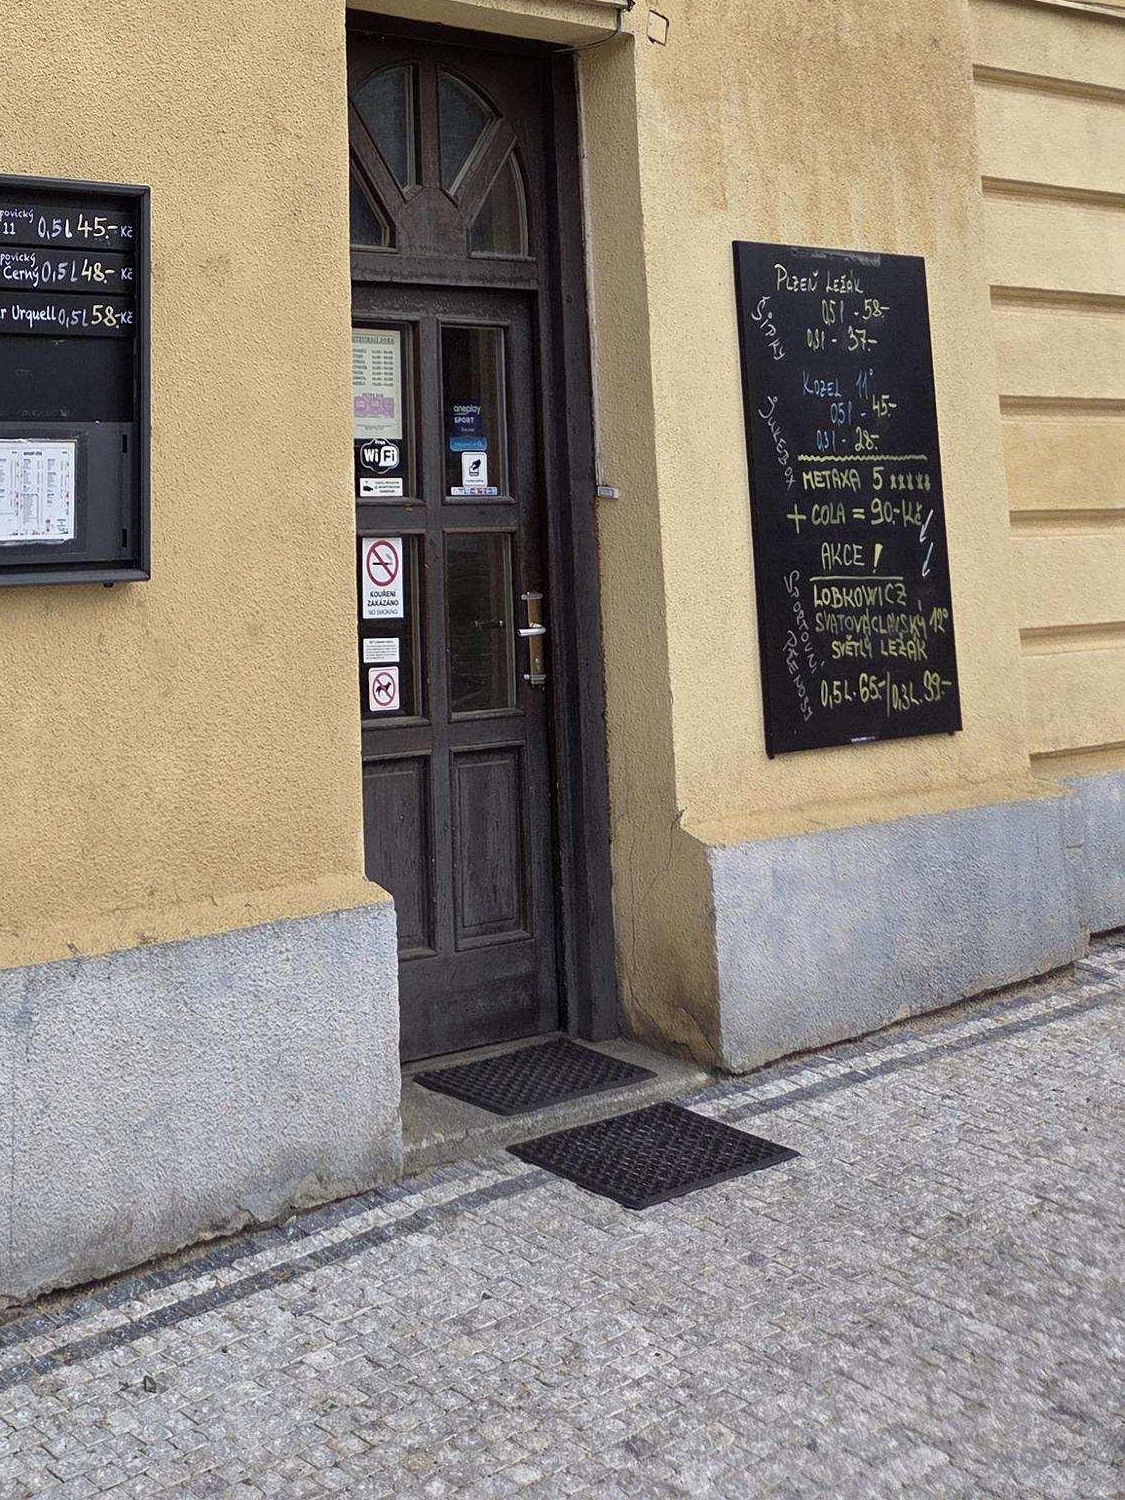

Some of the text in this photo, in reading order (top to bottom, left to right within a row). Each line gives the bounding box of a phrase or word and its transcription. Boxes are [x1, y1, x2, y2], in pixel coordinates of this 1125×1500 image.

[3, 221, 16, 235] 11
[120, 226, 133, 238] Kč
[3, 261, 39, 287] Černý
[121, 268, 133, 280] Kč
[11, 305, 57, 328] Urquell
[120, 312, 133, 324] Kč
[802, 466, 884, 492] METAXA 5
[811, 502, 846, 526] COLA
[820, 542, 866, 571] AKCE
[813, 583, 907, 609] LOBKOWICZ
